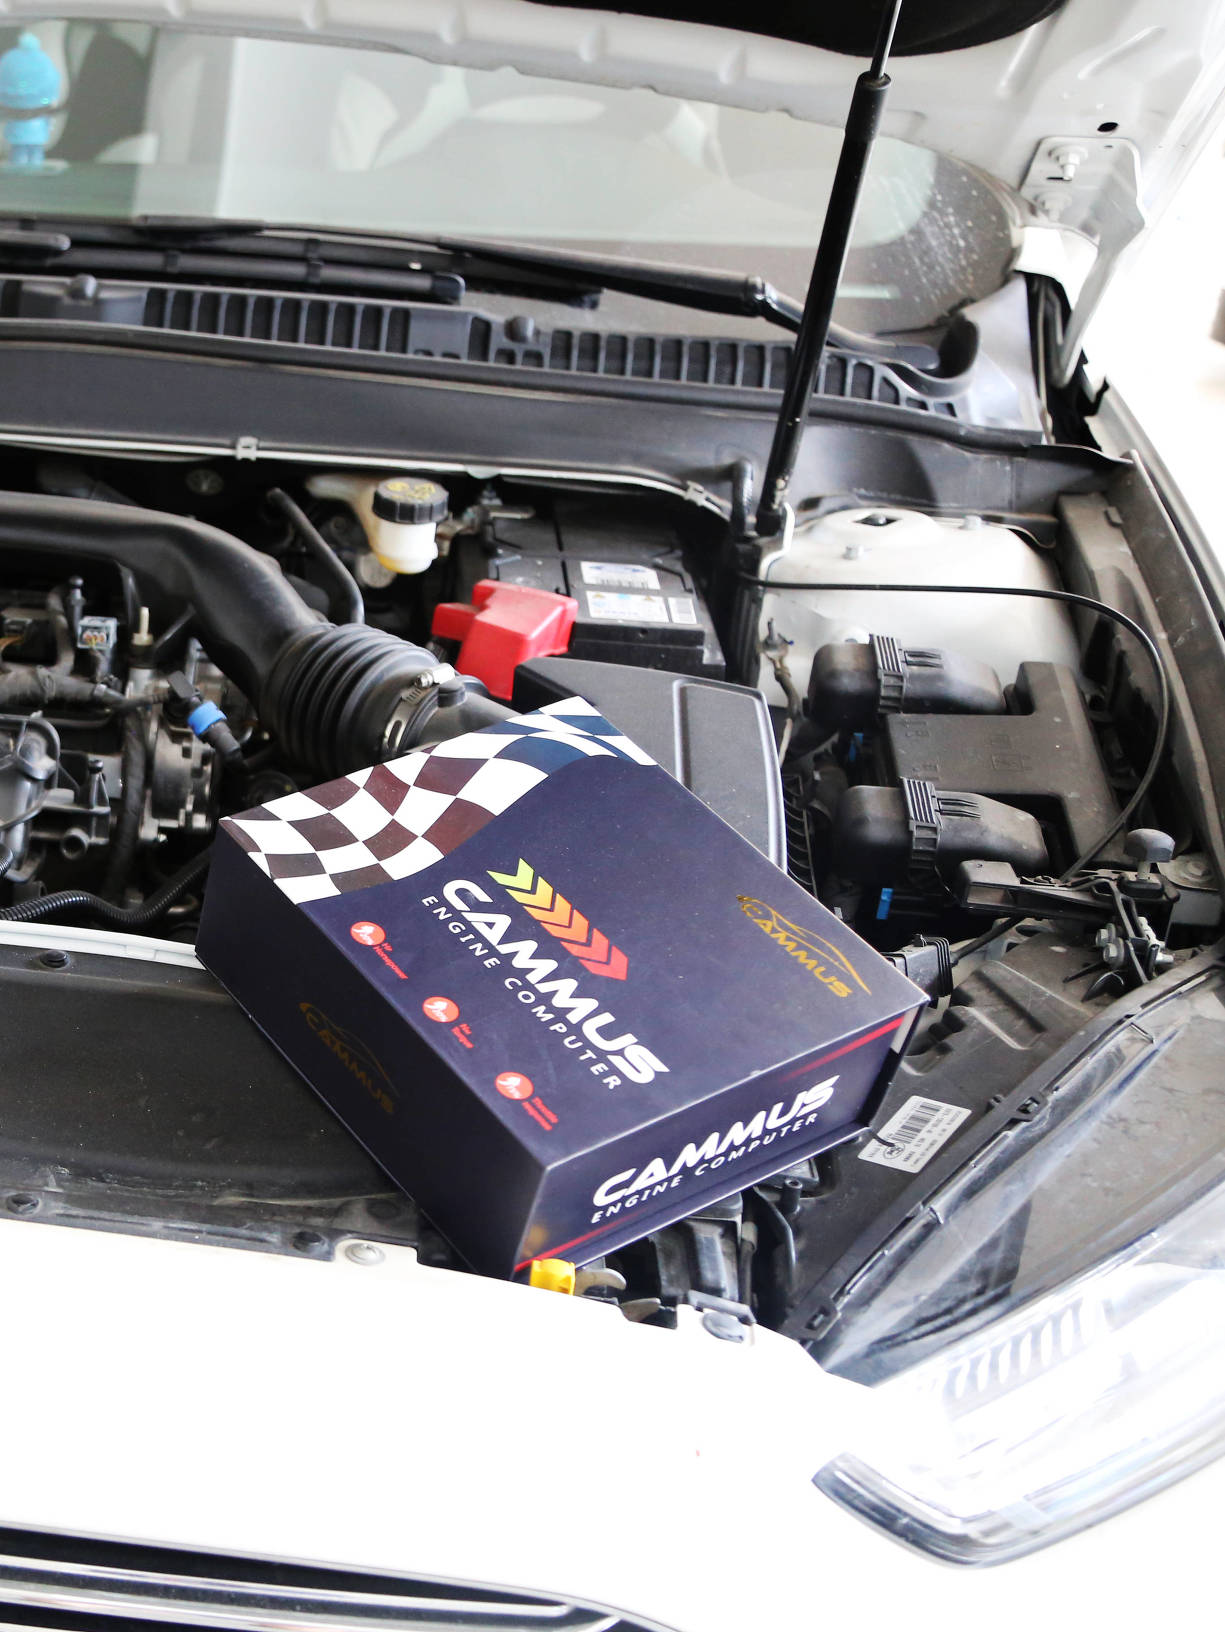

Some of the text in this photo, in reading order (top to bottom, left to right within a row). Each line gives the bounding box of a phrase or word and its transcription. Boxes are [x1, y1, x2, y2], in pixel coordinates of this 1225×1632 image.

[421, 895, 622, 1090] ENGINE COMPUTER
[443, 879, 671, 1084] CAMMUS
[740, 903, 854, 998] CAMMUS
[590, 1174, 684, 1224] ENGINE
[694, 1112, 818, 1177] COMPUTER
[592, 1074, 841, 1208] CAMMUS
